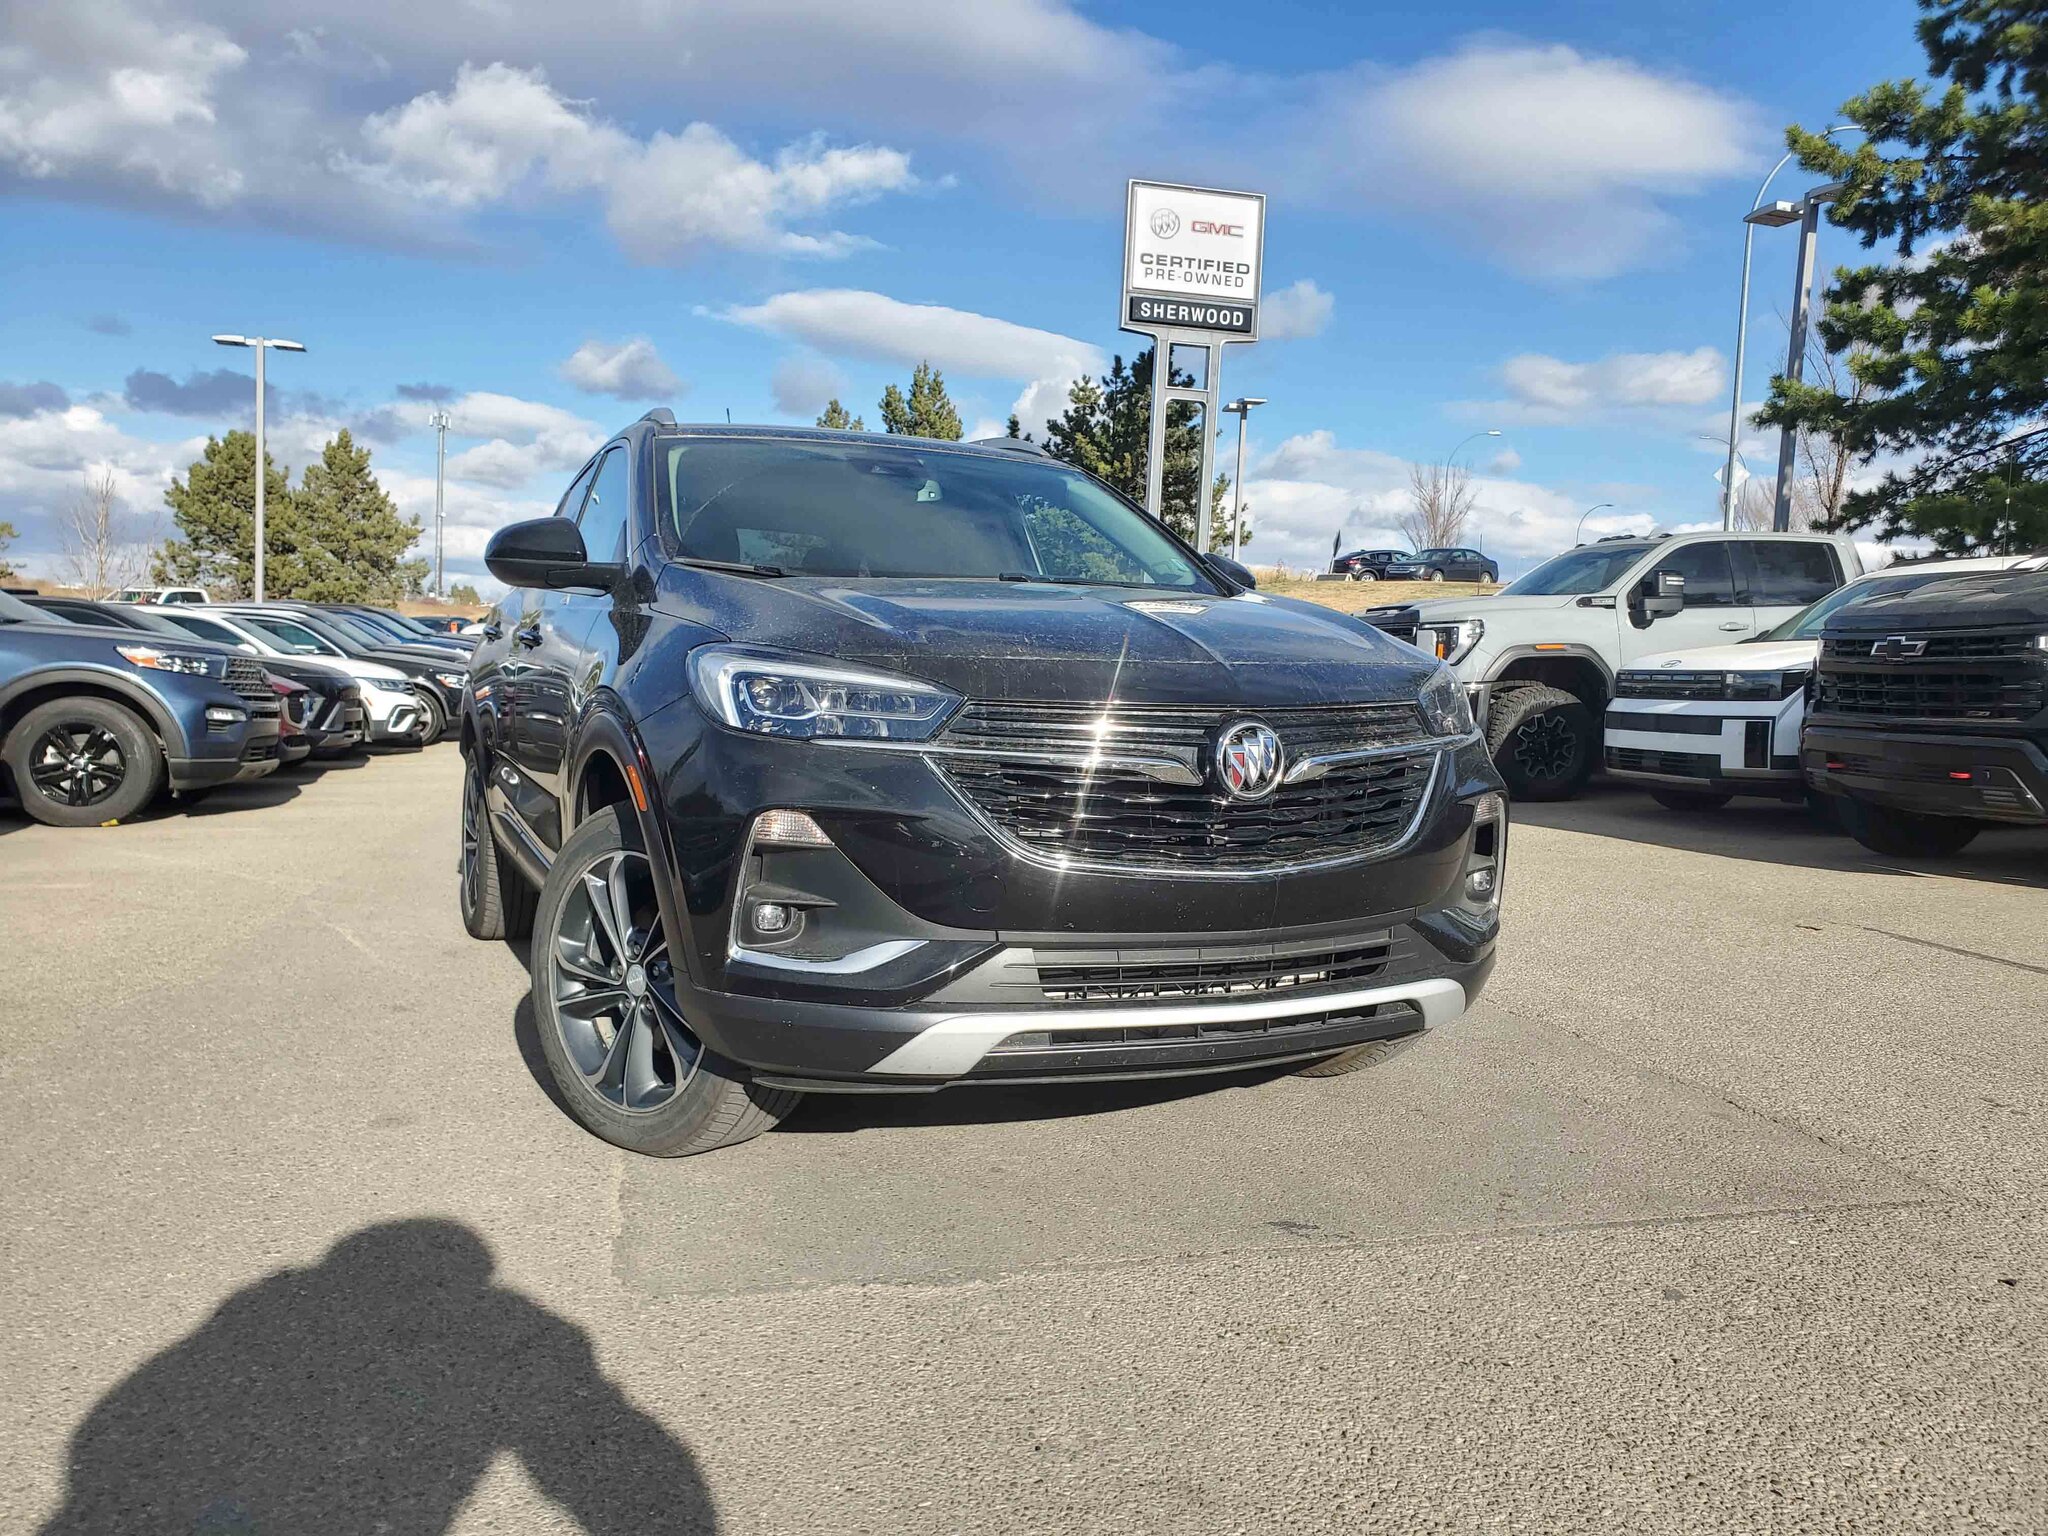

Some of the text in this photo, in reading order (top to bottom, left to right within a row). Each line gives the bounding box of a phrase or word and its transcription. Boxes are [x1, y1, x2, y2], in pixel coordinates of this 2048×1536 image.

[1191, 220, 1244, 238] GMC
[1140, 252, 1250, 275] CERTIFIED
[1144, 267, 1244, 288] PRE-OWNED
[1140, 301, 1244, 326] SHERWOOD
